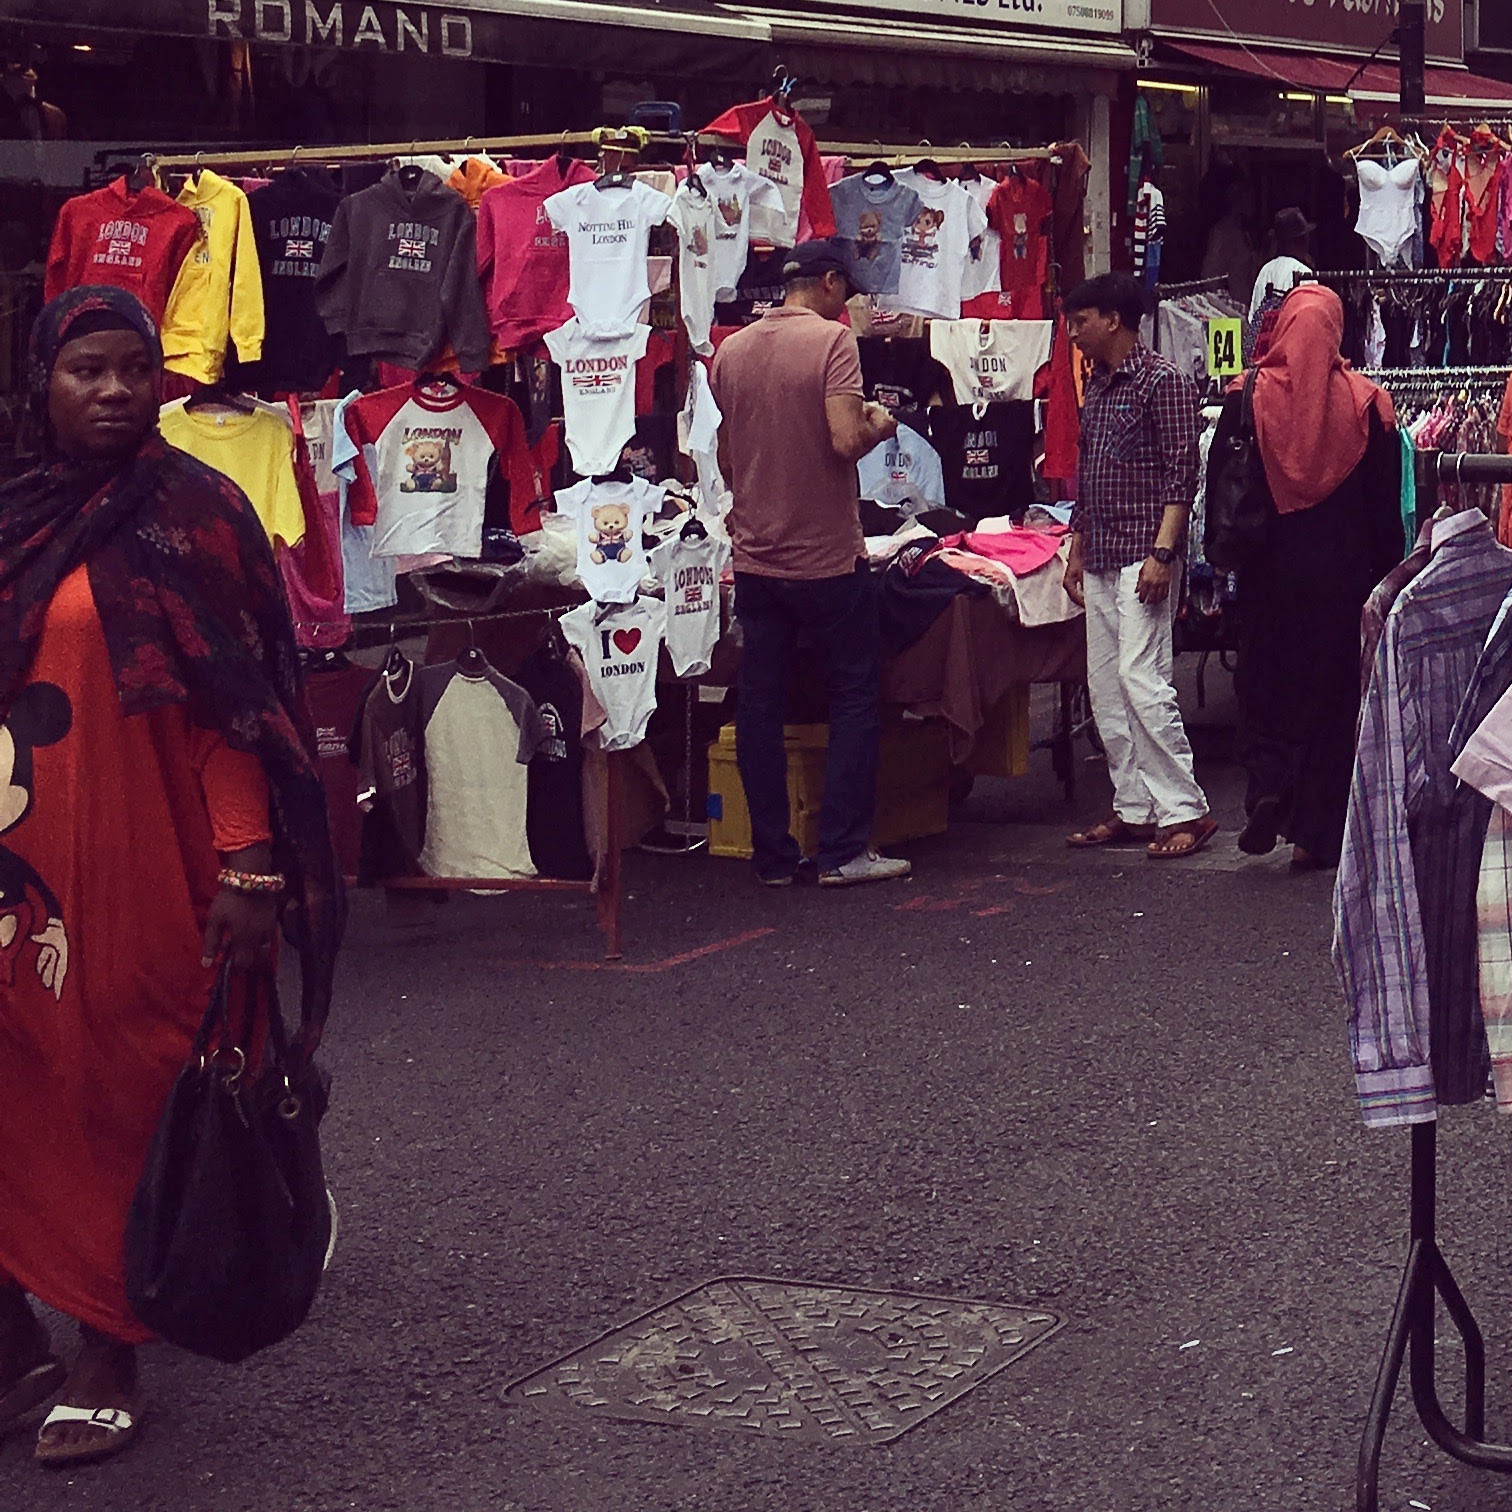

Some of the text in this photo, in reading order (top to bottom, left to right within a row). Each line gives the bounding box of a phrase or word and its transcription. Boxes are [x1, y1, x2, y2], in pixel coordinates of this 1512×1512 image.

[96, 220, 149, 246] LONDON
[269, 215, 333, 244] LONDON
[387, 222, 440, 246] LONDON
[617, 219, 636, 232] HIL
[591, 233, 628, 245] LONDON
[271, 260, 320, 278] ENGLAN
[1213, 329, 1236, 369] £4
[564, 354, 629, 374] LONDON
[403, 427, 463, 446] LONDON
[673, 566, 714, 593] LONDON
[600, 629, 612, 660] I
[600, 661, 646, 678] LONDON
